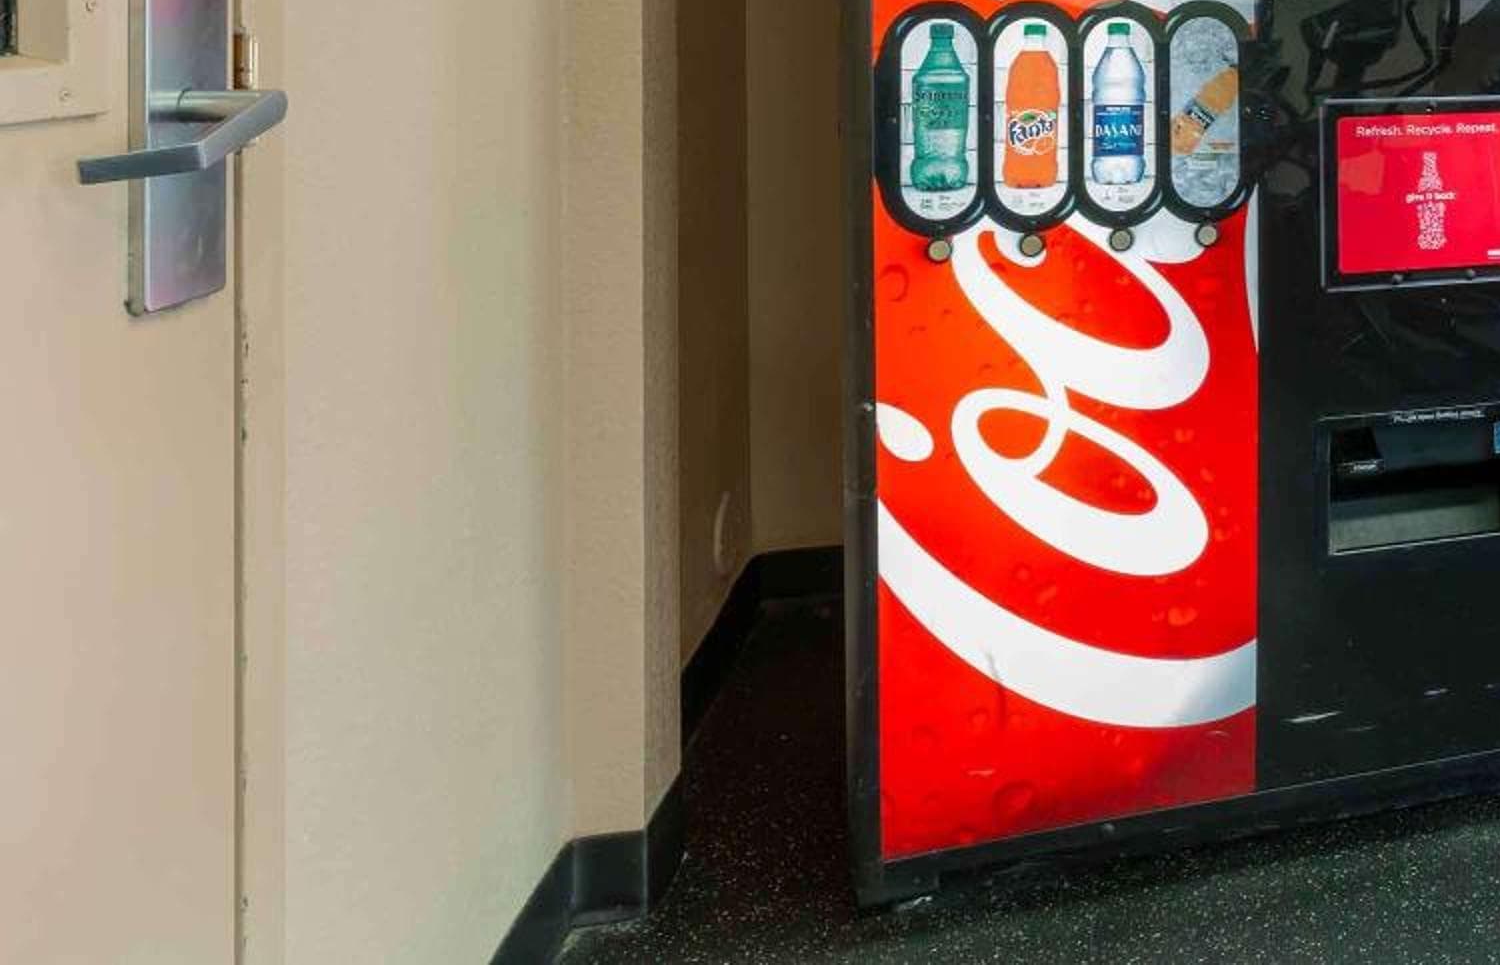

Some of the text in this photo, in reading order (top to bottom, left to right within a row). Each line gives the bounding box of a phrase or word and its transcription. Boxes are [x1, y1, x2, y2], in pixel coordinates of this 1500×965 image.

[1356, 122, 1500, 137] Refresh. Recycle. Repeat.
